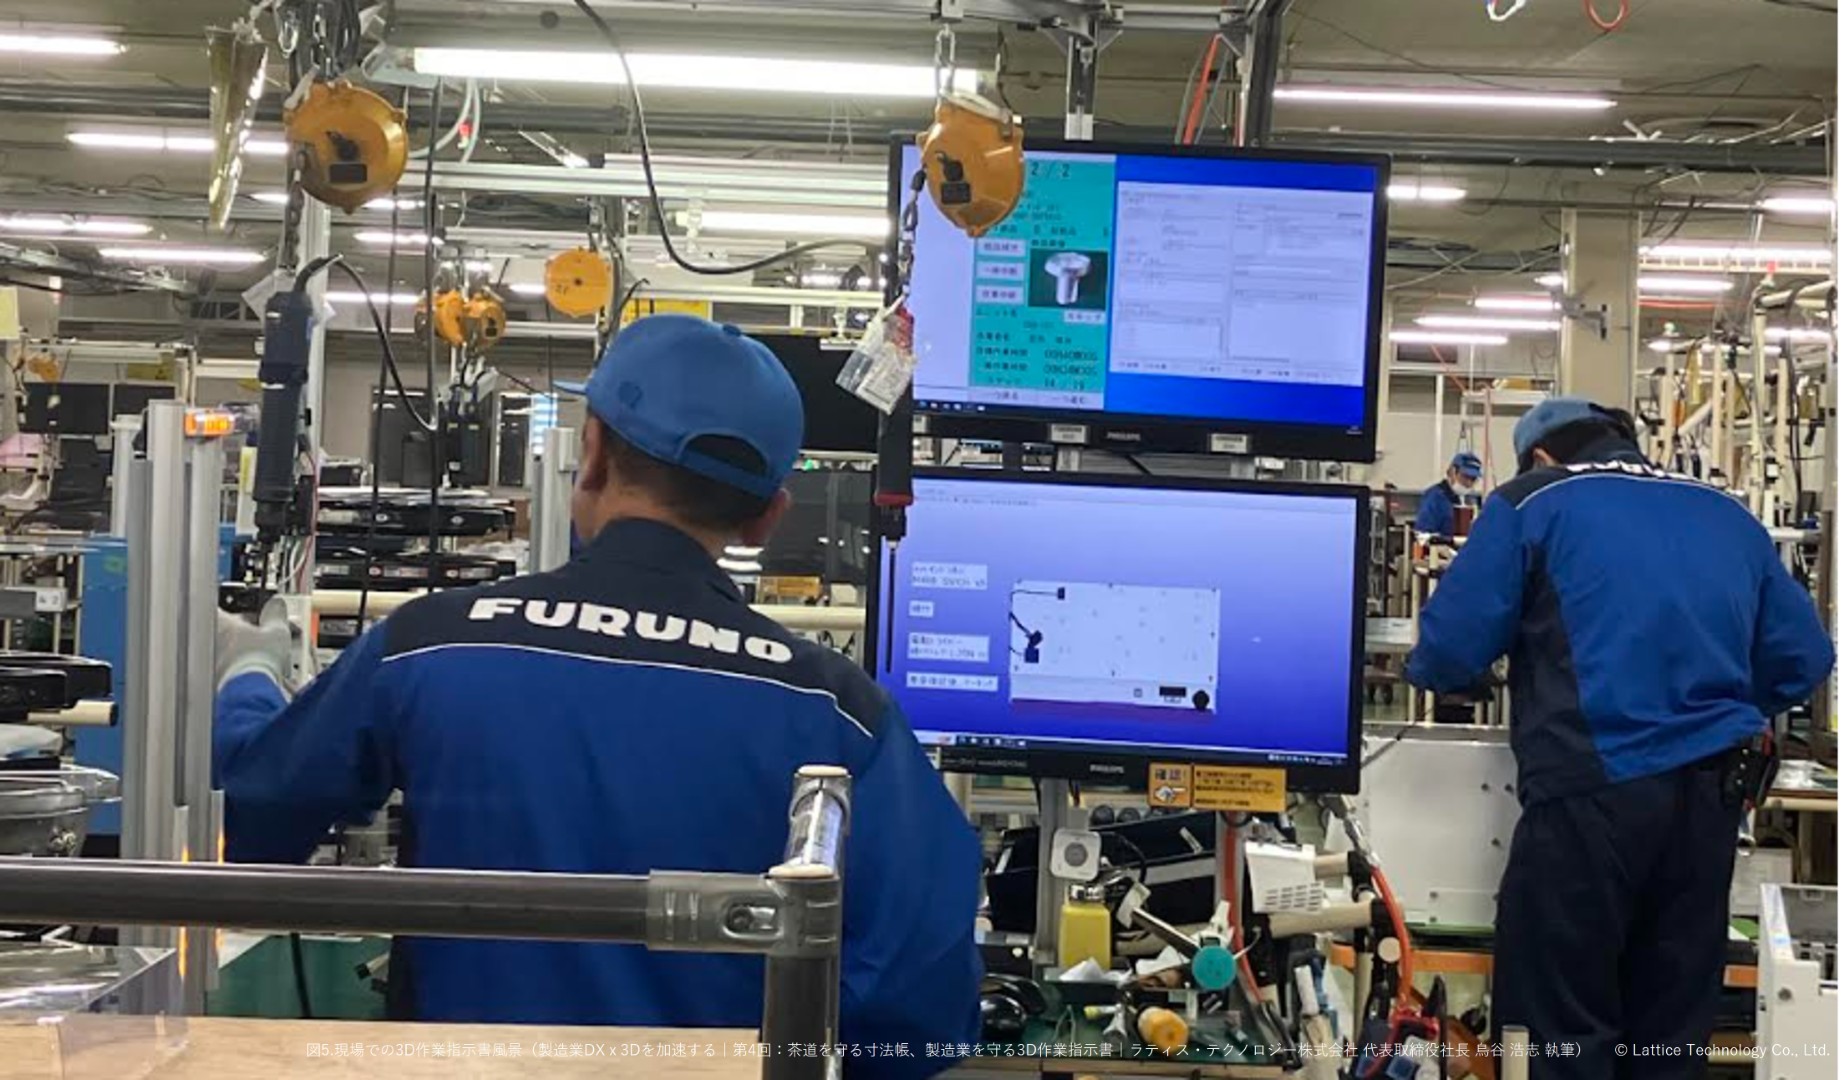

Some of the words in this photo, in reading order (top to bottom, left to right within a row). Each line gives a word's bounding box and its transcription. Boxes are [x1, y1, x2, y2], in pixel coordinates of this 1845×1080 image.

[1031, 162, 1039, 176] 2
[1062, 164, 1070, 177] 2
[468, 597, 793, 663] FURUNO
